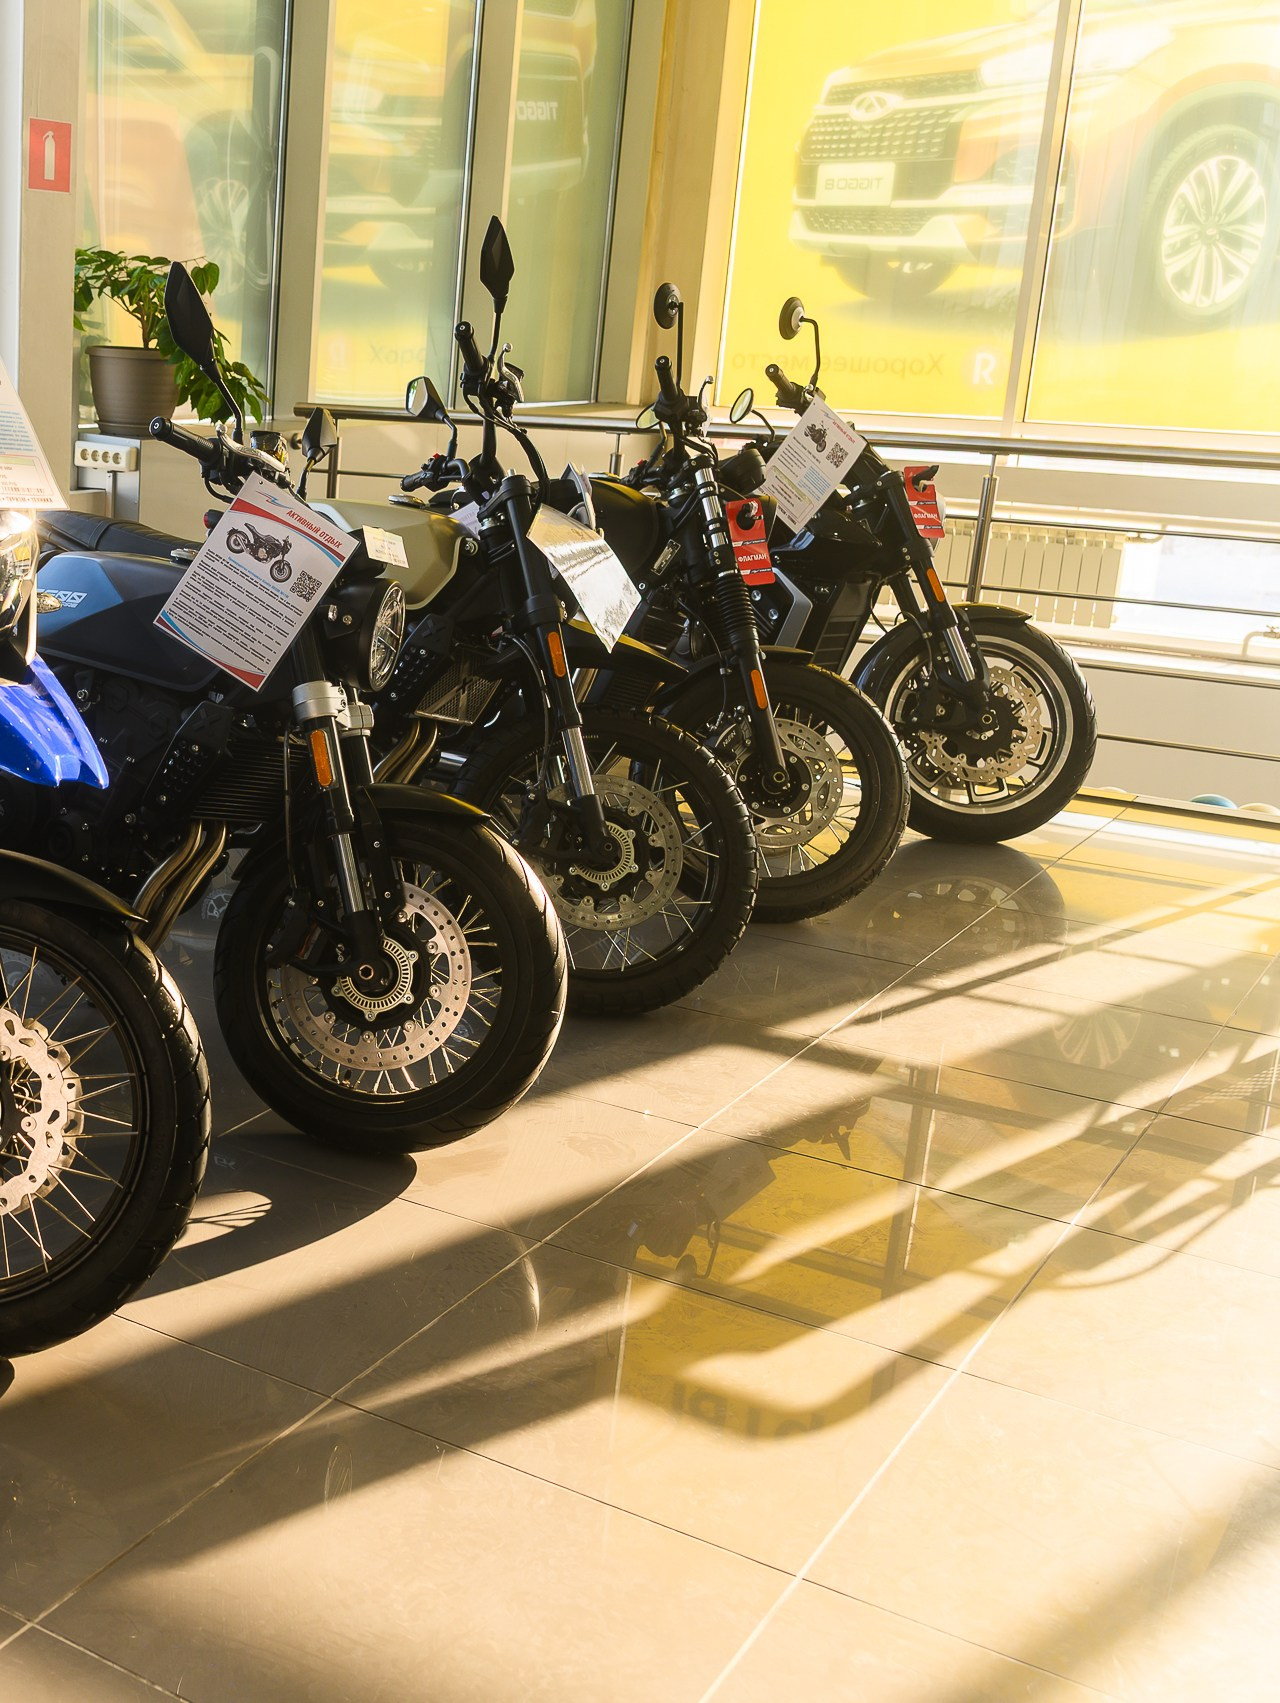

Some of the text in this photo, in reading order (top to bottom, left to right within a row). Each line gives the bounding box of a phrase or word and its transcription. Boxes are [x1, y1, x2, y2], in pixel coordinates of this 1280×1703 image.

[286, 509, 344, 549] АКТИВНЫЙ ОТДЫХ
[737, 552, 767, 563] ФЛАГМАН
